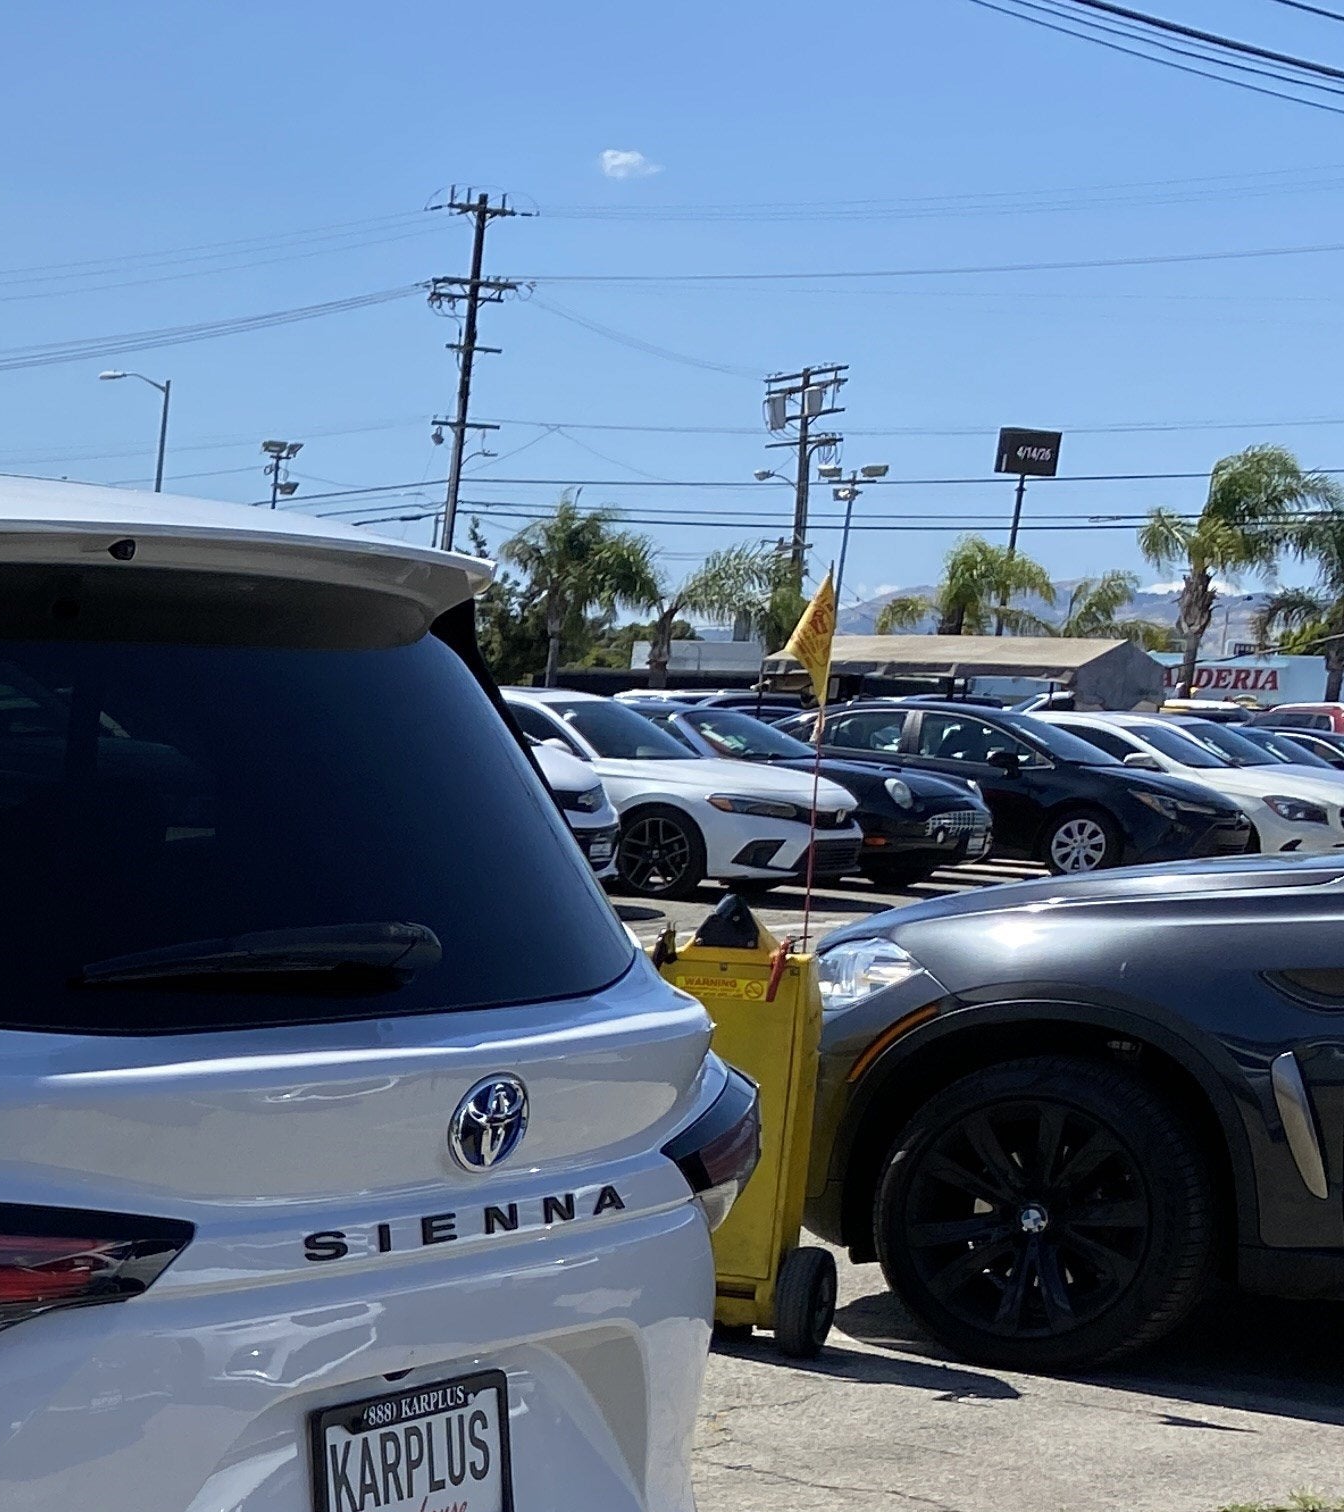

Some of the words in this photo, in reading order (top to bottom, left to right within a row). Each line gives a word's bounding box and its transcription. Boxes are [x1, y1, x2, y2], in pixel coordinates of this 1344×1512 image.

[685, 976, 737, 988] WARNING
[305, 1185, 626, 1262] SIENNA
[401, 1386, 465, 1419] KARPLUS
